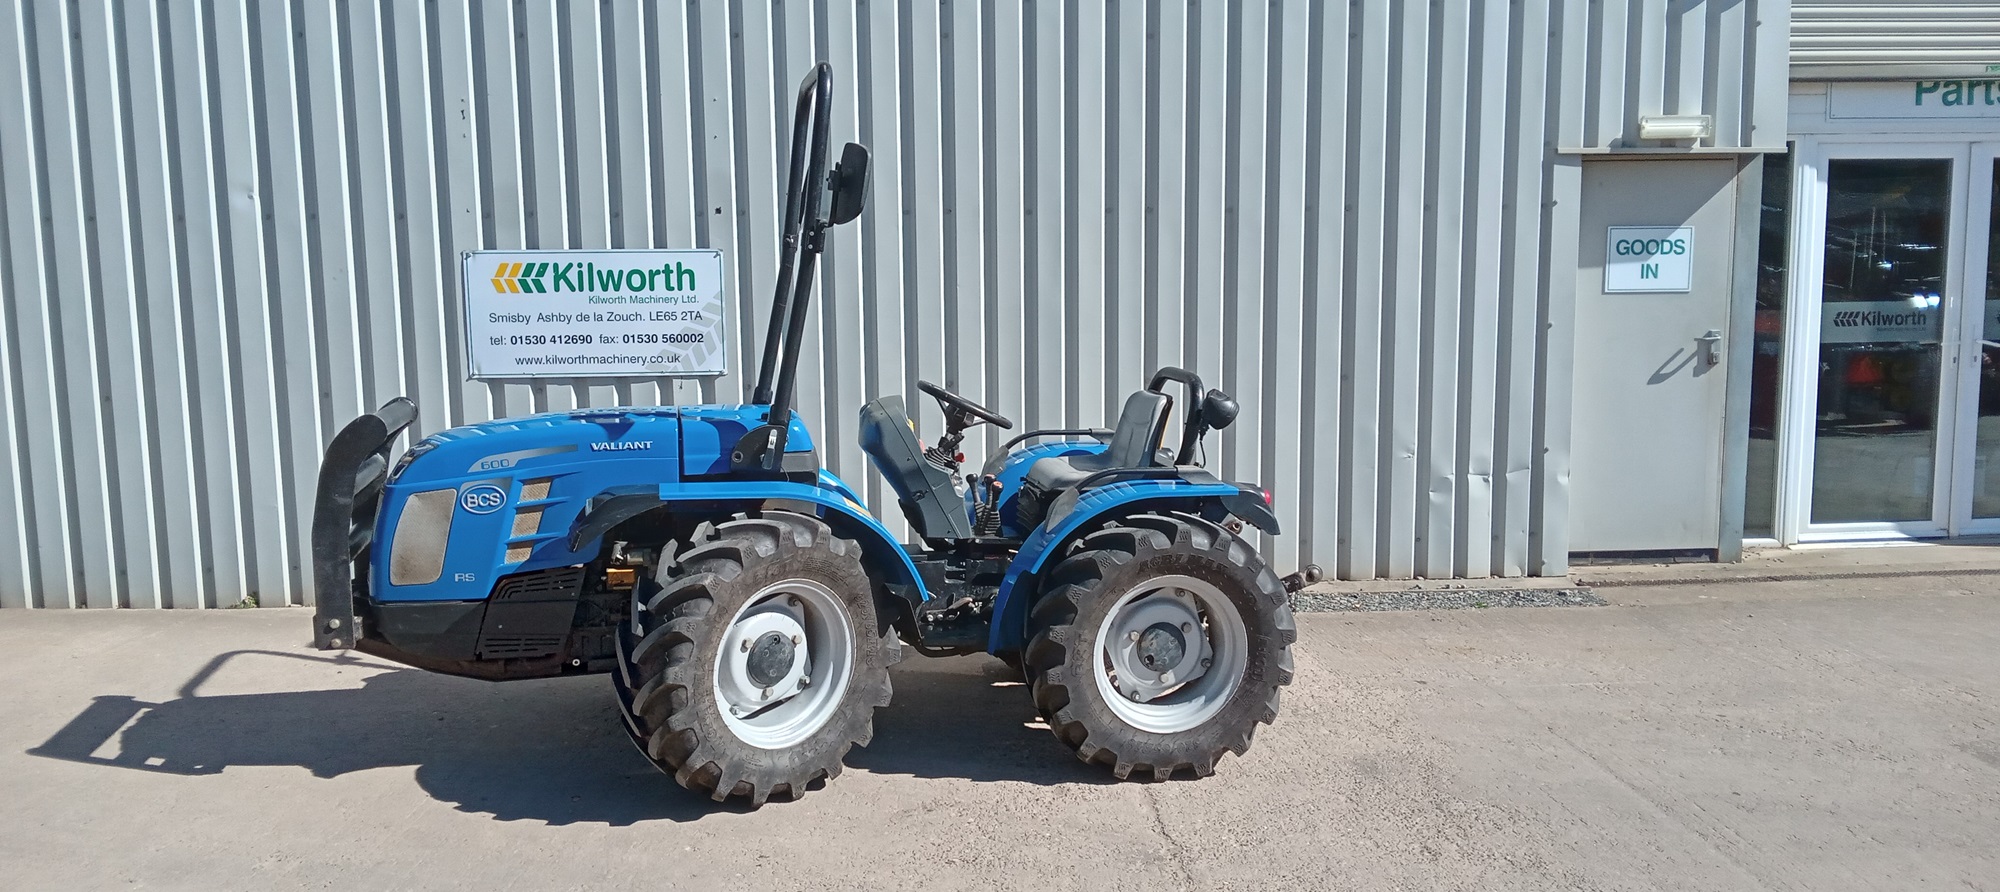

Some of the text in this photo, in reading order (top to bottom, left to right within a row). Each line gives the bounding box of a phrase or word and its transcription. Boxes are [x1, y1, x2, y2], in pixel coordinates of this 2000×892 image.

[1915, 80, 2000, 106] Part
[1616, 239, 1686, 255] GOODS
[552, 261, 696, 293] Kilworth
[1640, 263, 1659, 280] IN
[588, 293, 700, 305] Kilworth Machinery Ltd.
[489, 310, 703, 325] Smisby Ashby de la Zouch. LE65 2TA
[1861, 310, 1927, 326] Kilworth
[490, 333, 704, 346] tel: 01530 412690 fax: 01530 560002
[515, 353, 681, 366] www.kilworthmachinery.co.uk
[590, 440, 653, 452] VALIANT
[480, 458, 510, 470] 600
[466, 491, 501, 508] BCS
[454, 572, 475, 582] RS
